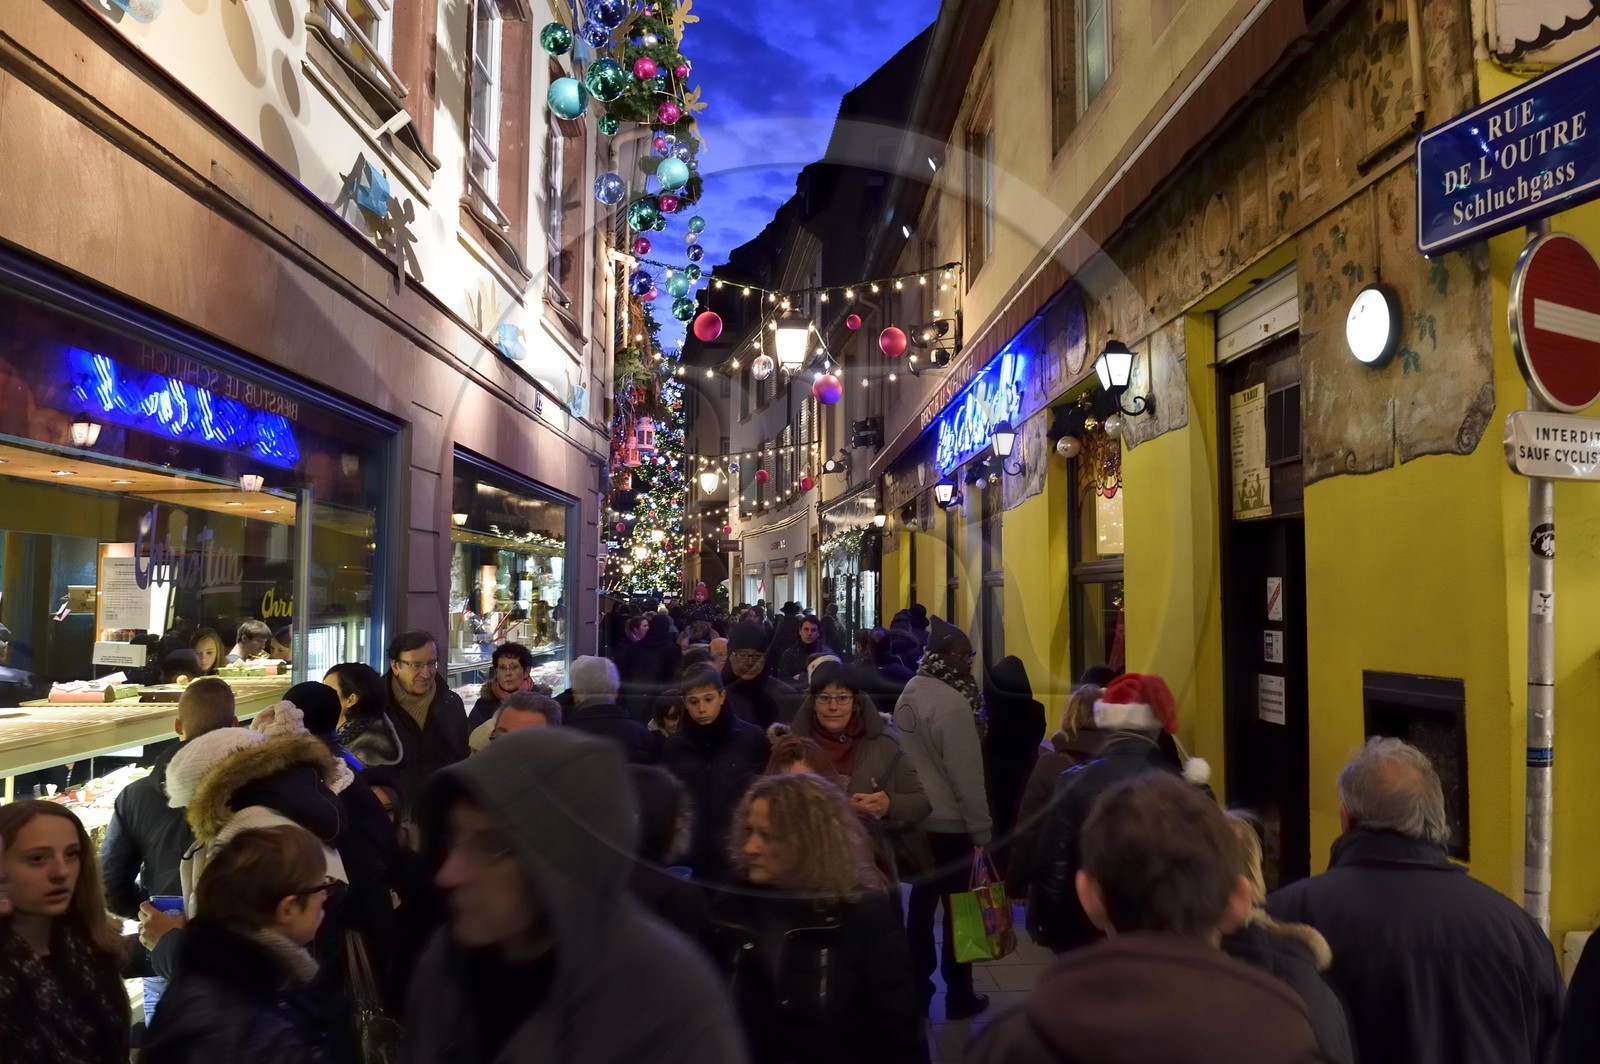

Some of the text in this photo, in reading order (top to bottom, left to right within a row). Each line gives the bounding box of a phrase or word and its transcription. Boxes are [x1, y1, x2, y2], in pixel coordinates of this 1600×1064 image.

[1488, 98, 1535, 142] RUE
[1444, 111, 1587, 196] DE L'OUTRE
[1453, 161, 1576, 226] Schluchgass
[1519, 445, 1600, 464] SAUF CYCLIS
[135, 503, 243, 590] Christian
